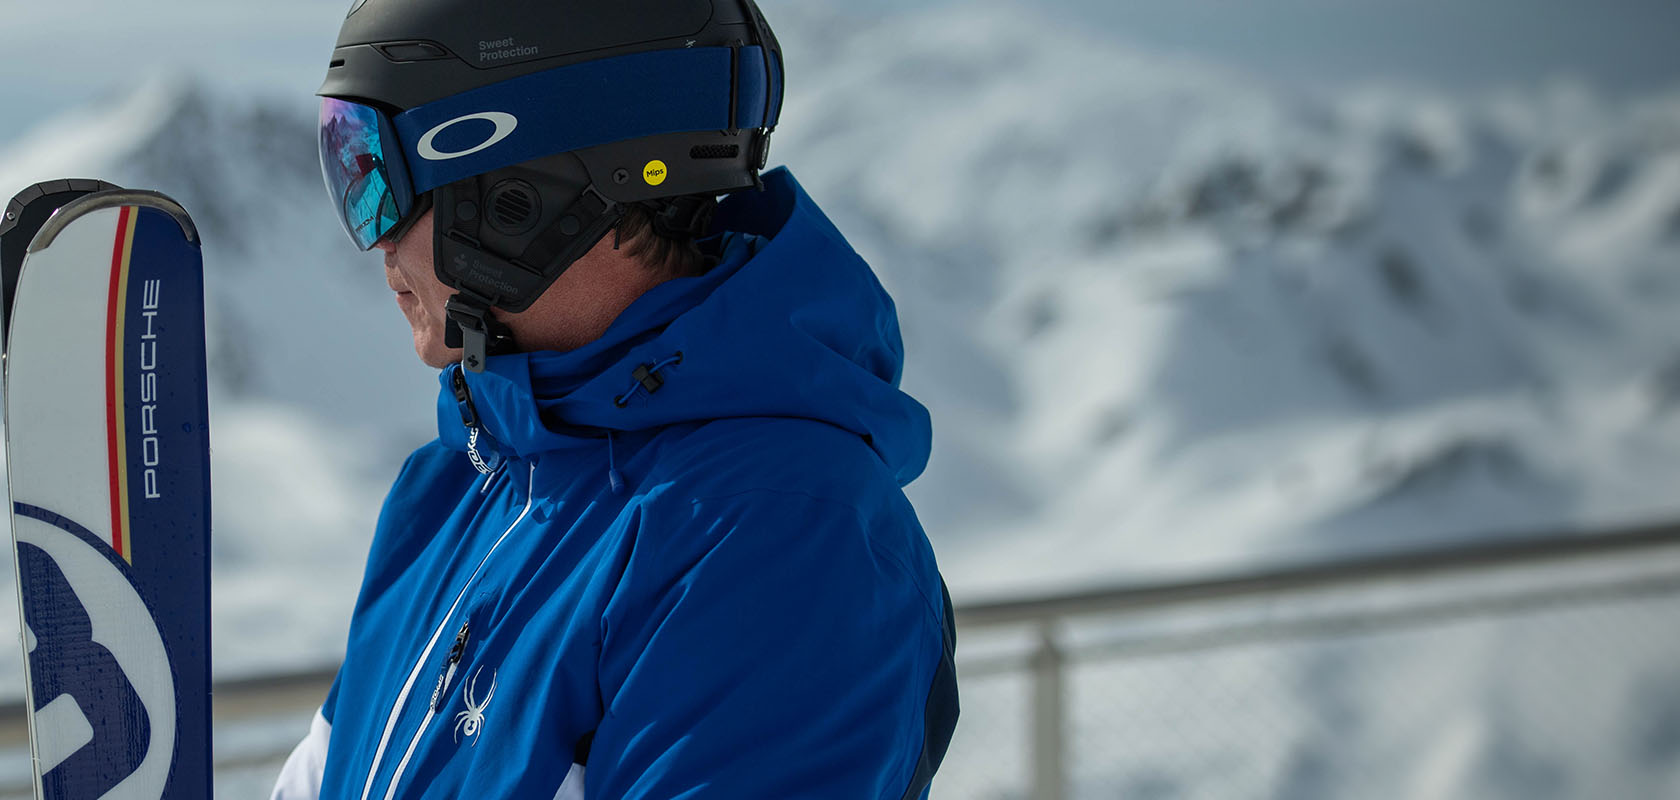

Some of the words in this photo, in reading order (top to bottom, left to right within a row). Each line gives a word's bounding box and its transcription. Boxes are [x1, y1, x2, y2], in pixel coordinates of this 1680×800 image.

[479, 37, 514, 50] Sweet
[480, 46, 538, 61] Protection
[646, 169, 664, 178] Mips
[141, 279, 160, 499] PORSCHE
